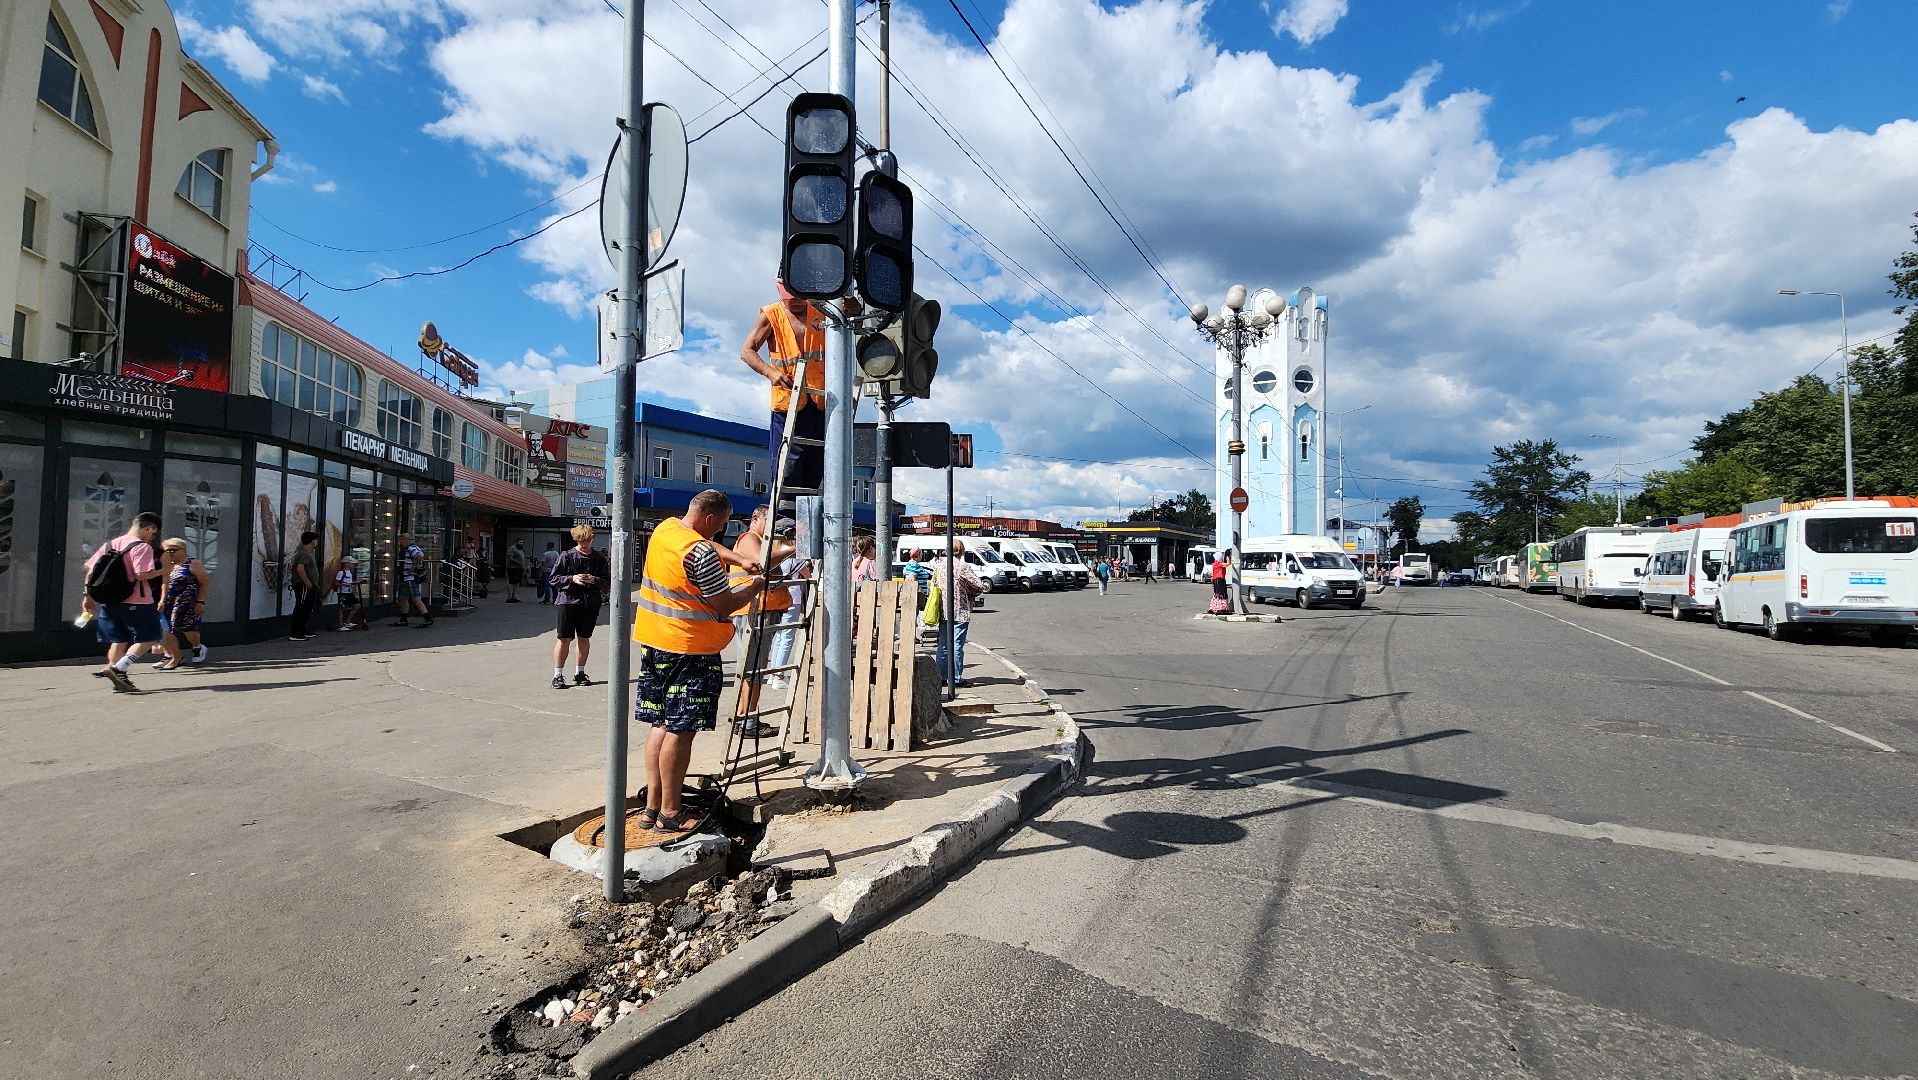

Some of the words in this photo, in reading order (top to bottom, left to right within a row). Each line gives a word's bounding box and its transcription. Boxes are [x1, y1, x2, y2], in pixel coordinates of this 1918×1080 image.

[49, 372, 175, 411] Мельница
[55, 398, 110, 411] хлебные
[115, 406, 172, 419] традиции
[549, 419, 591, 439] KFC
[345, 430, 386, 459] ПЕКАРНЯ
[391, 445, 428, 472] МЕЛЬНИЦА
